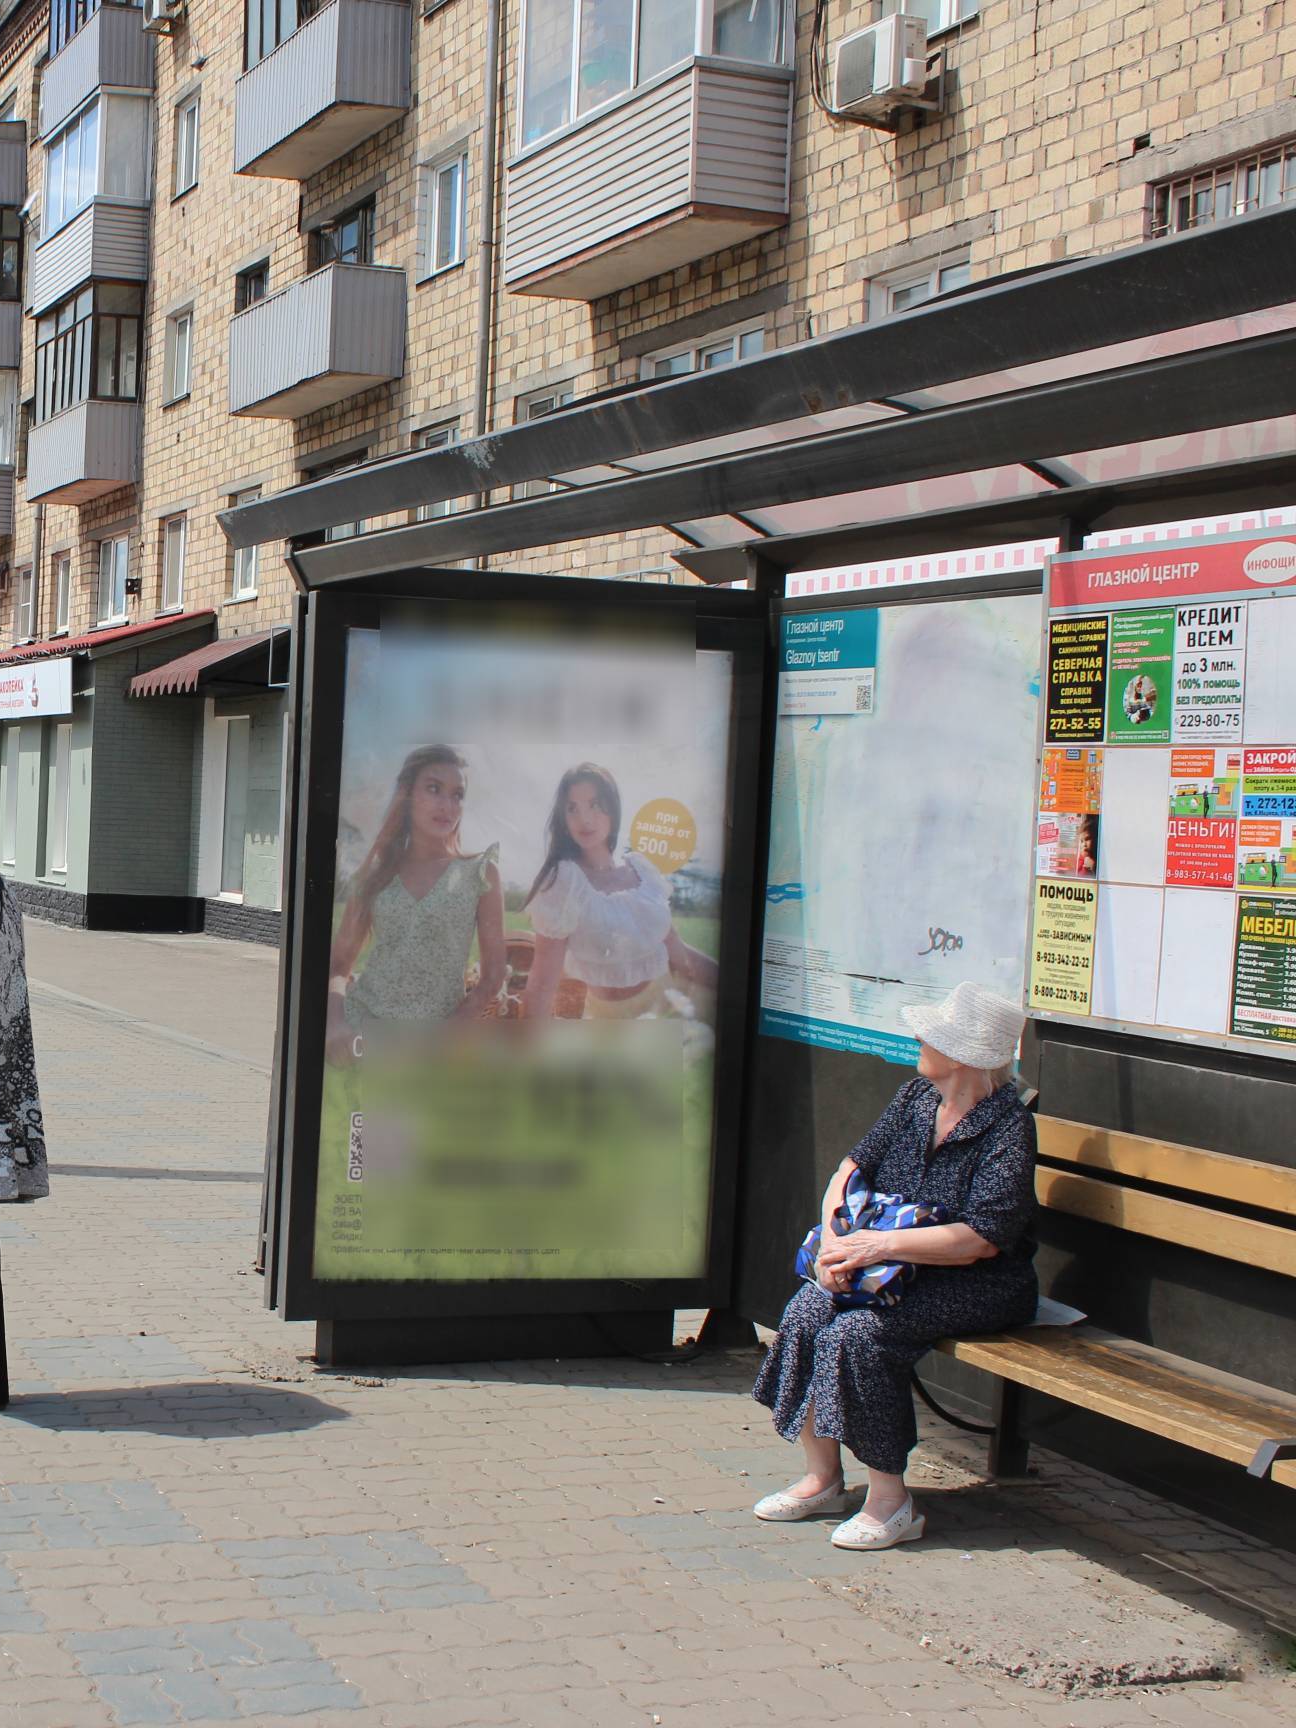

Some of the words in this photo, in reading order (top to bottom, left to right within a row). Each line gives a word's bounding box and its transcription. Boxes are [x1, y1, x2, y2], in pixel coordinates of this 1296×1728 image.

[1087, 563, 1150, 589] ГЛАЗНОЙ
[1152, 562, 1200, 585] ЦЕНТР
[1178, 606, 1241, 627] КРЕДИТ
[786, 618, 819, 635] Глазной
[819, 619, 844, 635] центр
[1052, 620, 1106, 634] МЕДИЦИНСКИЕ
[1078, 633, 1106, 642] СПРАВКИ
[1186, 629, 1234, 648] ВСЕМ
[786, 649, 816, 667] Glaznoy
[817, 648, 841, 663] tsentr
[1052, 657, 1103, 671] СЕВЕРНАЯ
[1199, 657, 1208, 673] 3
[1052, 670, 1103, 684] СПРАВКА
[1177, 678, 1201, 690] 100%
[1060, 687, 1092, 696] СПРАВКИ
[1176, 696, 1191, 705] БЕЗ
[1191, 694, 1242, 706] ПРЕДОПЛАТЫ
[1050, 718, 1101, 730] 271-52-55
[1180, 713, 1240, 727] 229-80-75
[656, 812, 679, 824] при
[636, 821, 674, 836] заказе
[677, 829, 690, 839] от
[1167, 820, 1234, 838] ДЕНЬГИ!
[638, 836, 668, 856] 500
[1166, 869, 1233, 882] 8-983-577-41-46
[1040, 884, 1094, 903] ПОМОЩЬ
[1036, 951, 1089, 968] 8-923-342-22-22
[1034, 985, 1087, 1003] 8-800-222-78-28
[1236, 1008, 1272, 1020] БЕСПЛАТНАЯ
